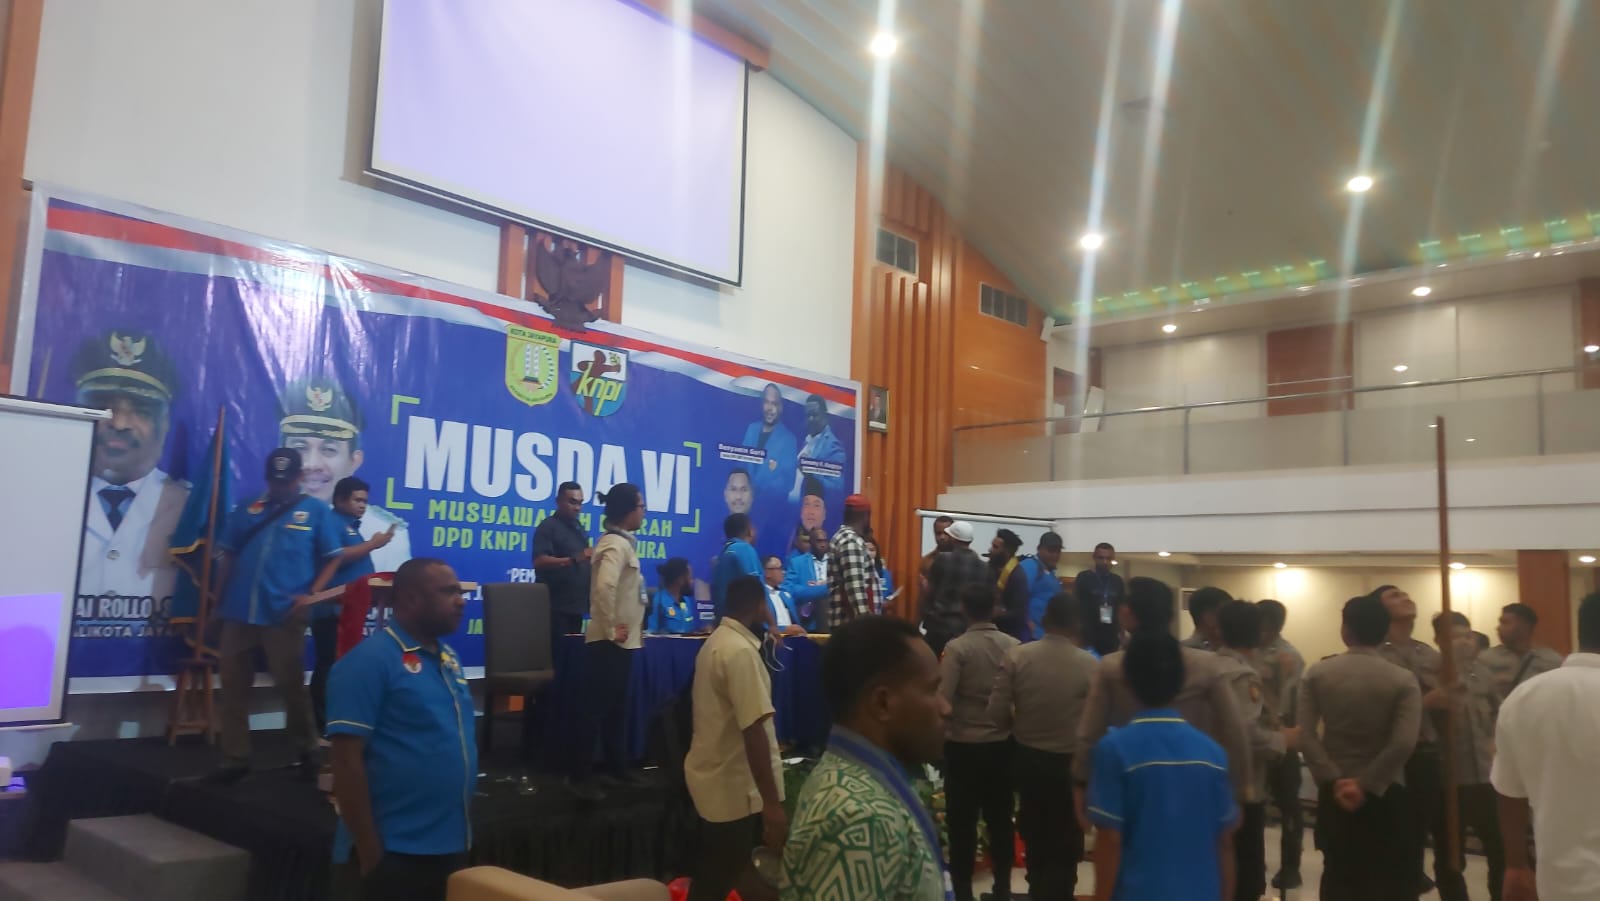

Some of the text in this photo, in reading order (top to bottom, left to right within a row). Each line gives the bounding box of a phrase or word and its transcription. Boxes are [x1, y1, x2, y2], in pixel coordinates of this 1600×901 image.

[403, 415, 691, 515] MUSDA VI
[432, 526, 527, 552] DPD KNPI
